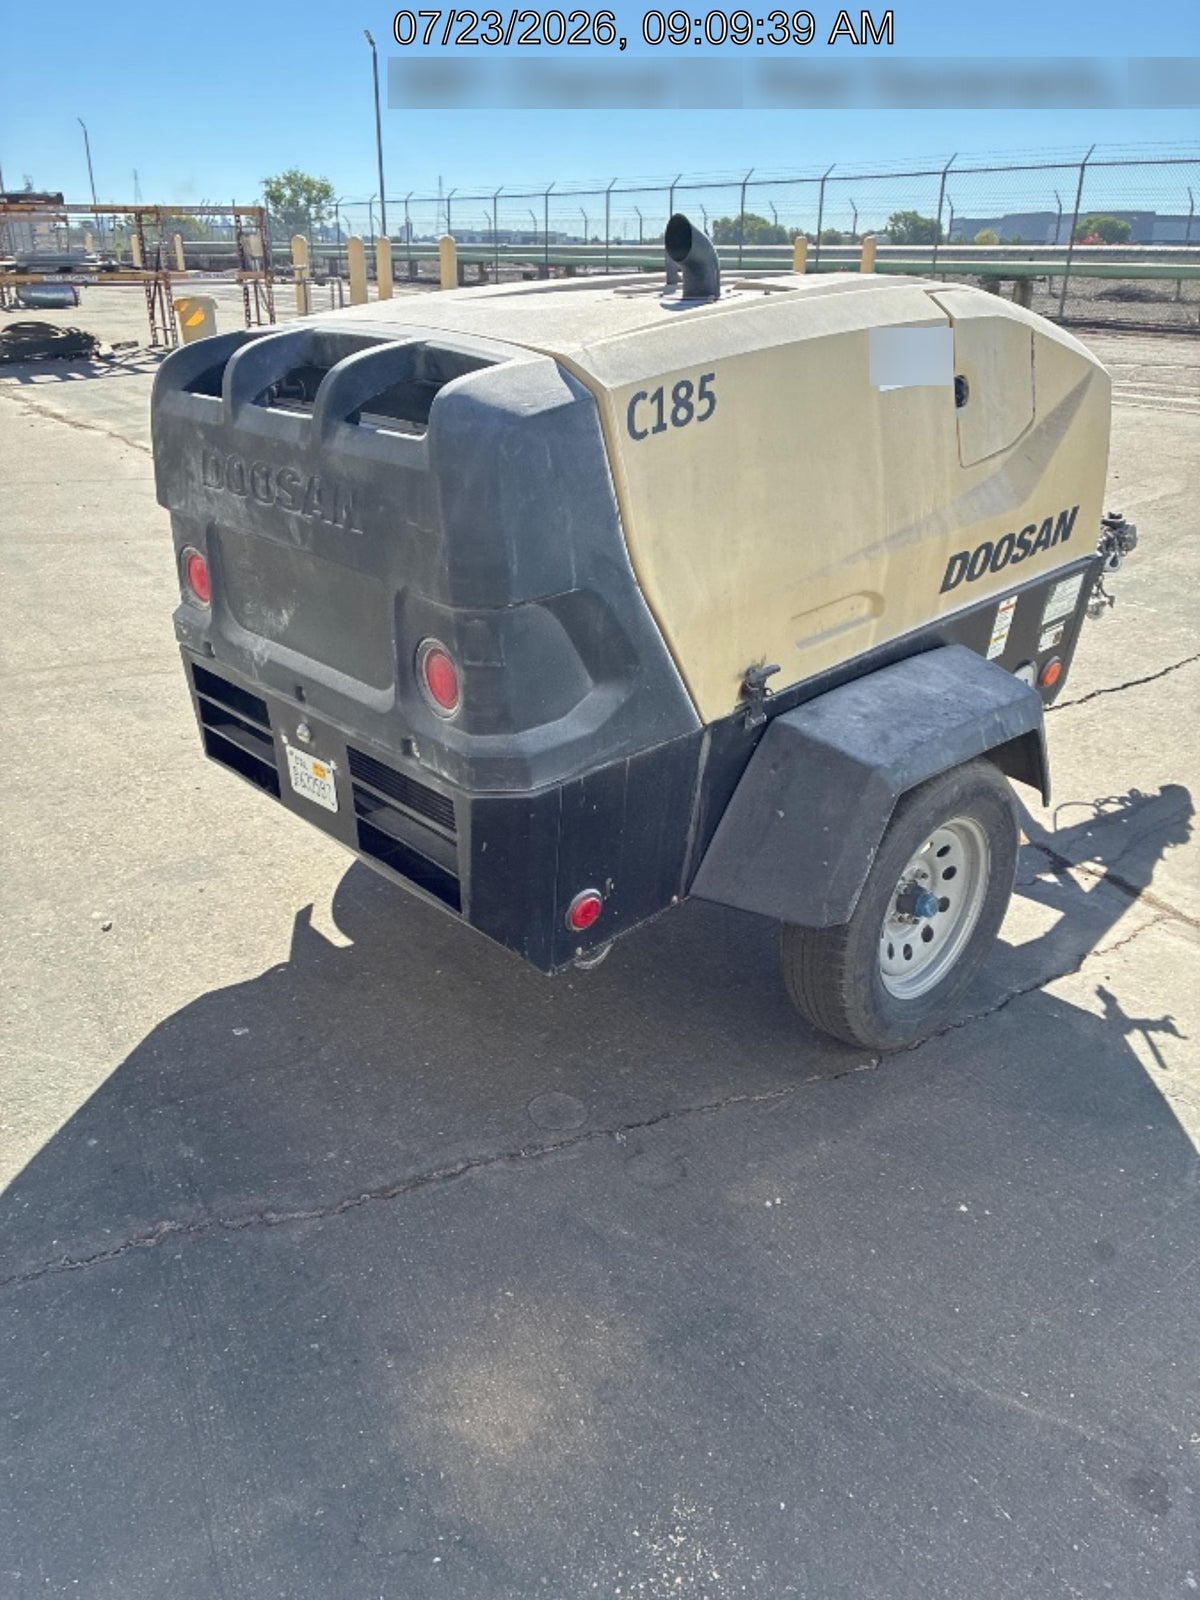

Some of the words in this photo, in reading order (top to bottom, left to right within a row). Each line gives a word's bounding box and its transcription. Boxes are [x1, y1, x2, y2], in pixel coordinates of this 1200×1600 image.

[626, 372, 717, 441] C185
[202, 449, 364, 535] DOOSAN
[938, 504, 1081, 595] DOOSAN
